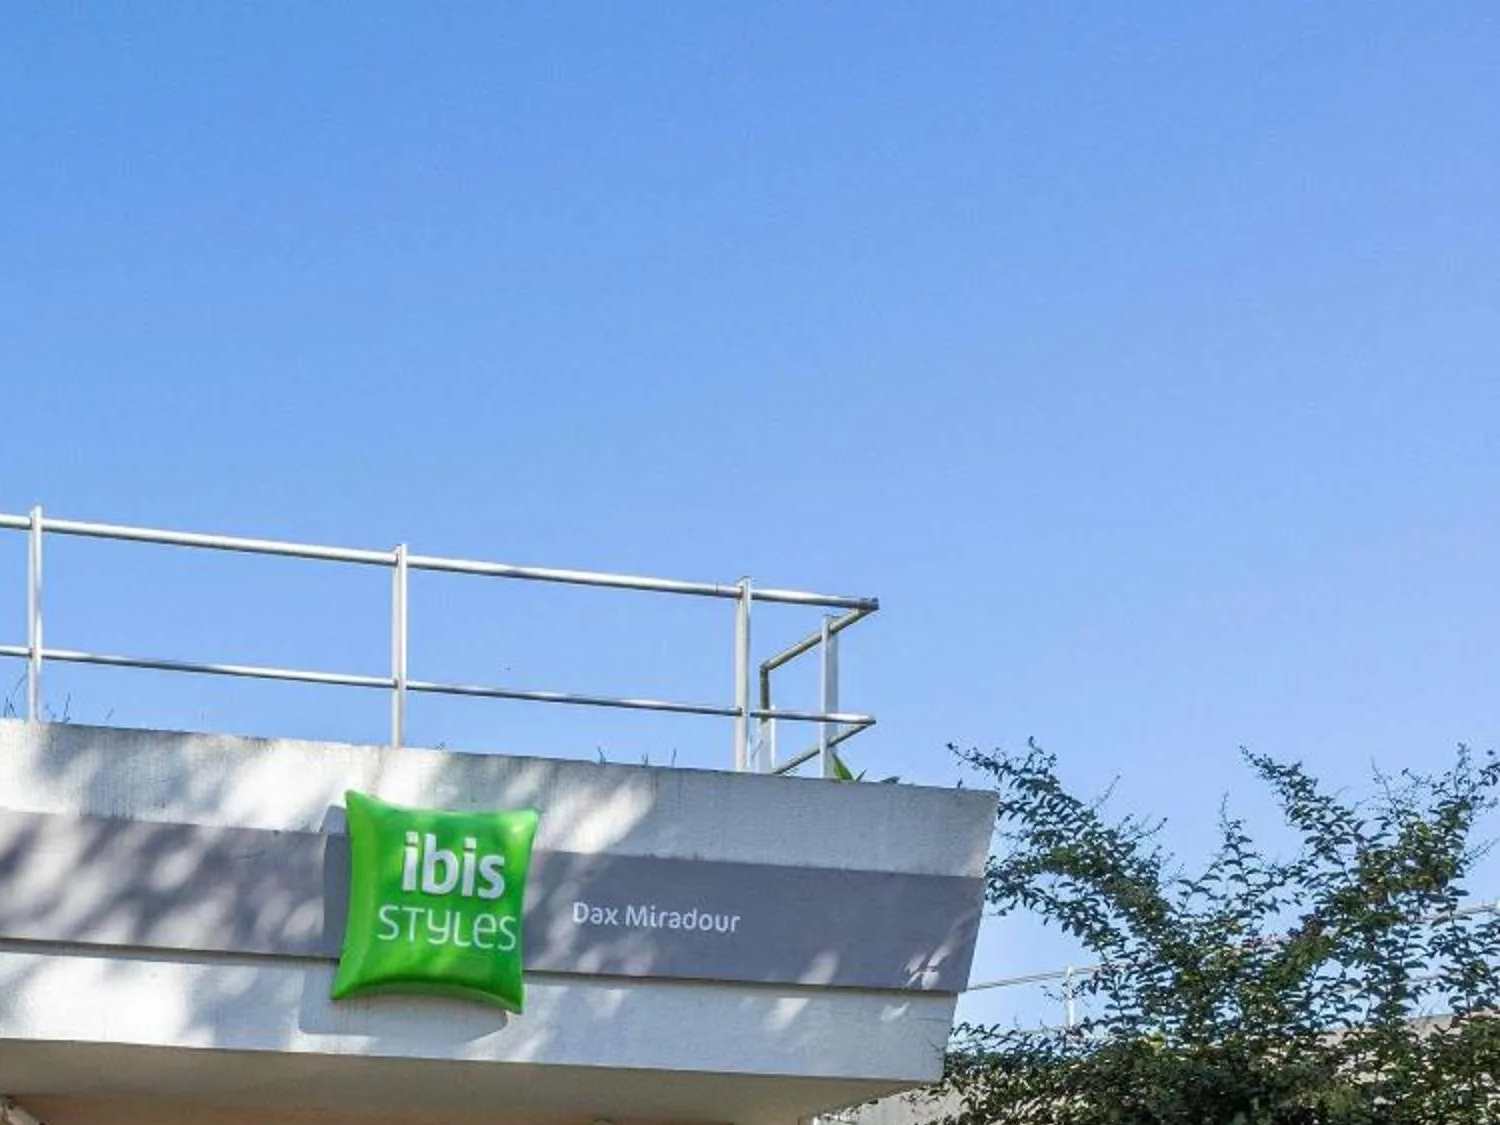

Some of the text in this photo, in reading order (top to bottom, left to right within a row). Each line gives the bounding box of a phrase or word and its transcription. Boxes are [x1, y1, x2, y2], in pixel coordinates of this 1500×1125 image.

[402, 831, 505, 899] ibis
[572, 901, 741, 933] Dax Miradour
